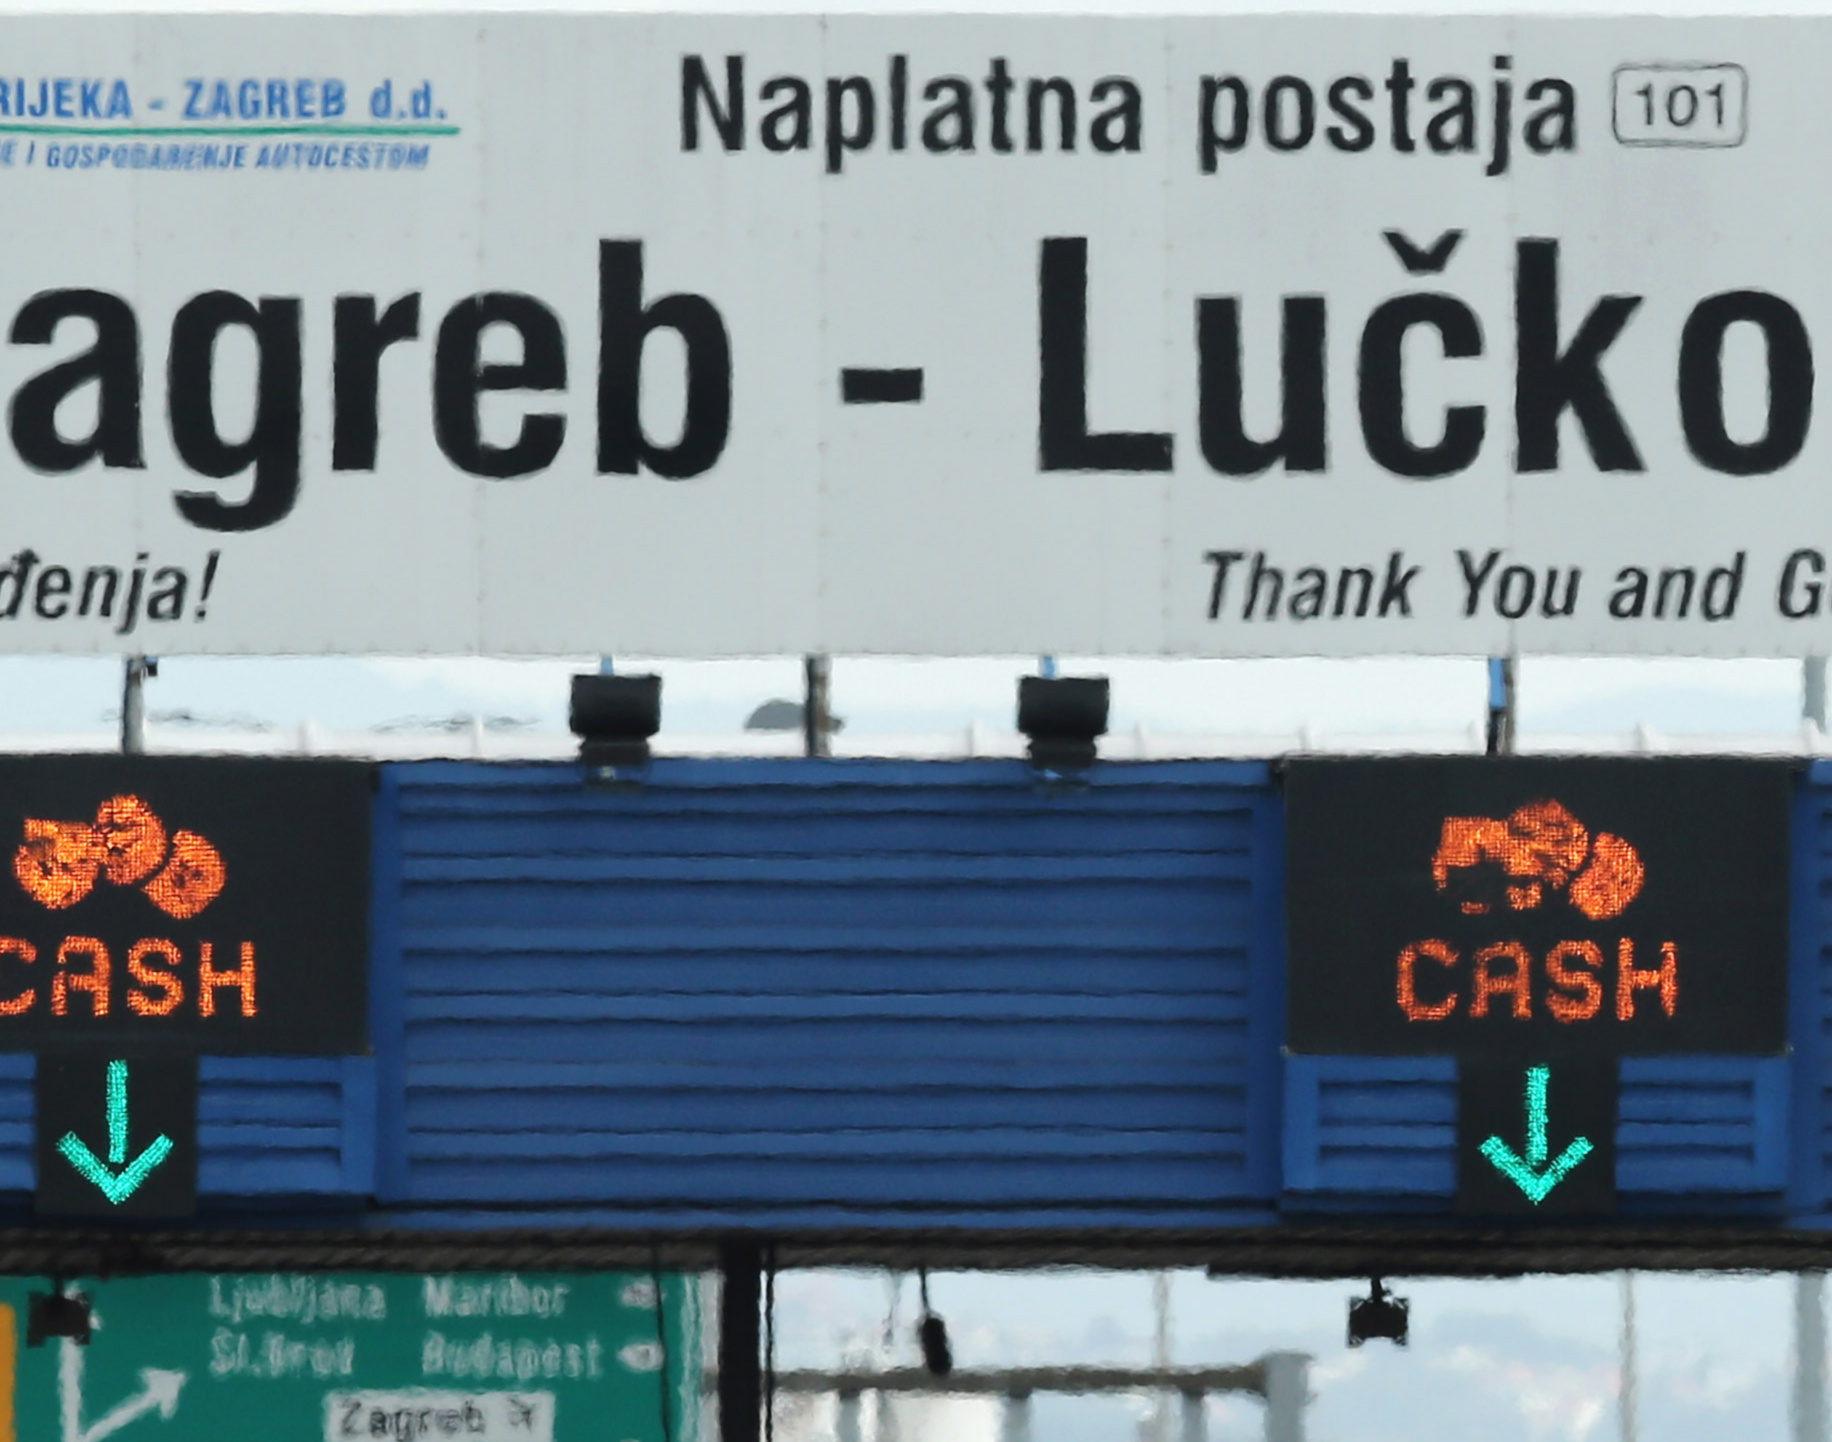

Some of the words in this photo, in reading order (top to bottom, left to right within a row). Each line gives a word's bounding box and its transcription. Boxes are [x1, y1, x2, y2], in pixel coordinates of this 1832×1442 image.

[181, 78, 347, 121] ZAGREB
[370, 79, 448, 121] d.d.
[682, 55, 1141, 174] Naplatna
[1199, 56, 1576, 176] postaja
[1634, 82, 1731, 130] 101
[255, 141, 431, 172] AUTOCESTOM
[842, 367, 924, 405] -
[1038, 230, 1815, 479] Lučko
[1204, 550, 1419, 621] Thank
[1456, 549, 1582, 620] You
[1608, 550, 1746, 622] and
[1397, 936, 1680, 1023] CASH
[422, 1330, 603, 1380] Budapest
